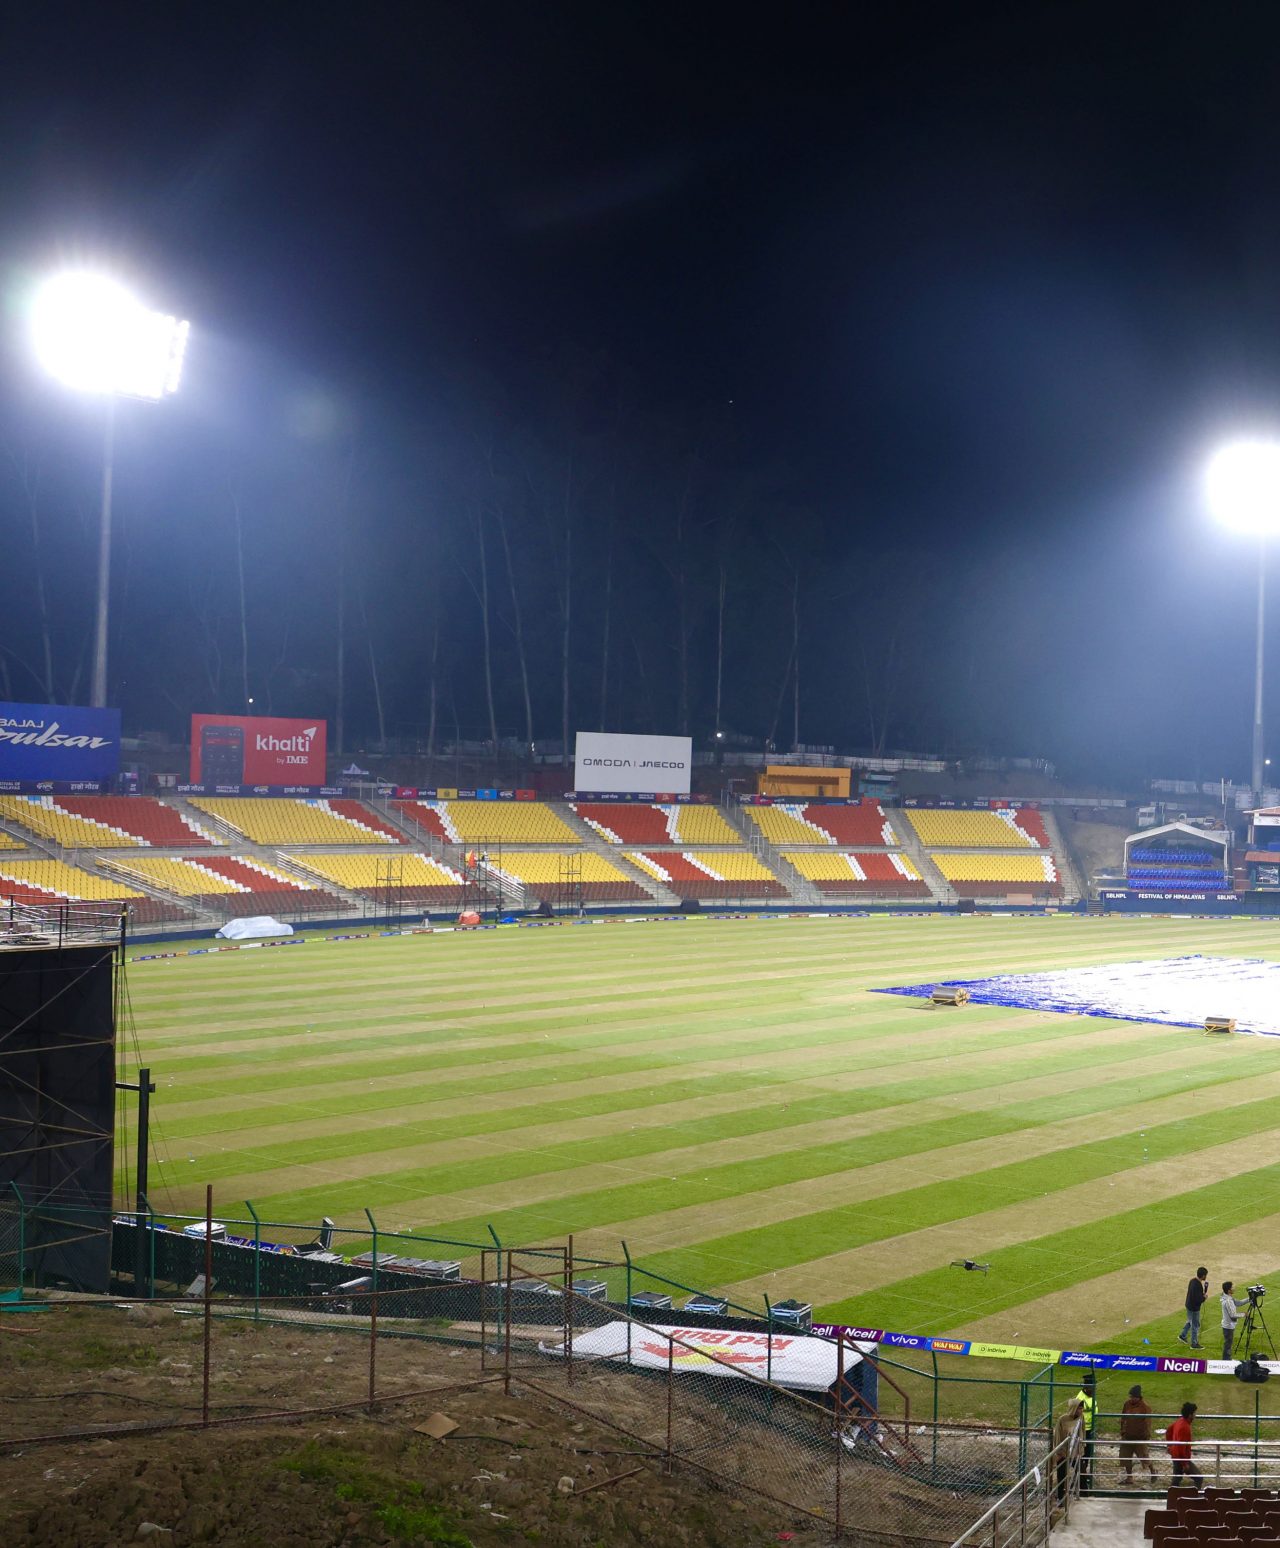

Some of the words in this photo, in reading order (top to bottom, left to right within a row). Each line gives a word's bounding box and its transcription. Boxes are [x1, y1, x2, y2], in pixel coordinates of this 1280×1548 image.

[256, 734, 310, 752] khalti
[276, 756, 285, 765] by
[286, 756, 308, 764] IME
[583, 758, 631, 767] OMODA
[639, 761, 685, 769] JAECOO
[811, 1326, 834, 1336] cell
[844, 1327, 877, 1339] Ncell
[891, 1335, 919, 1345] vivo
[1163, 1359, 1199, 1372] Ncell
